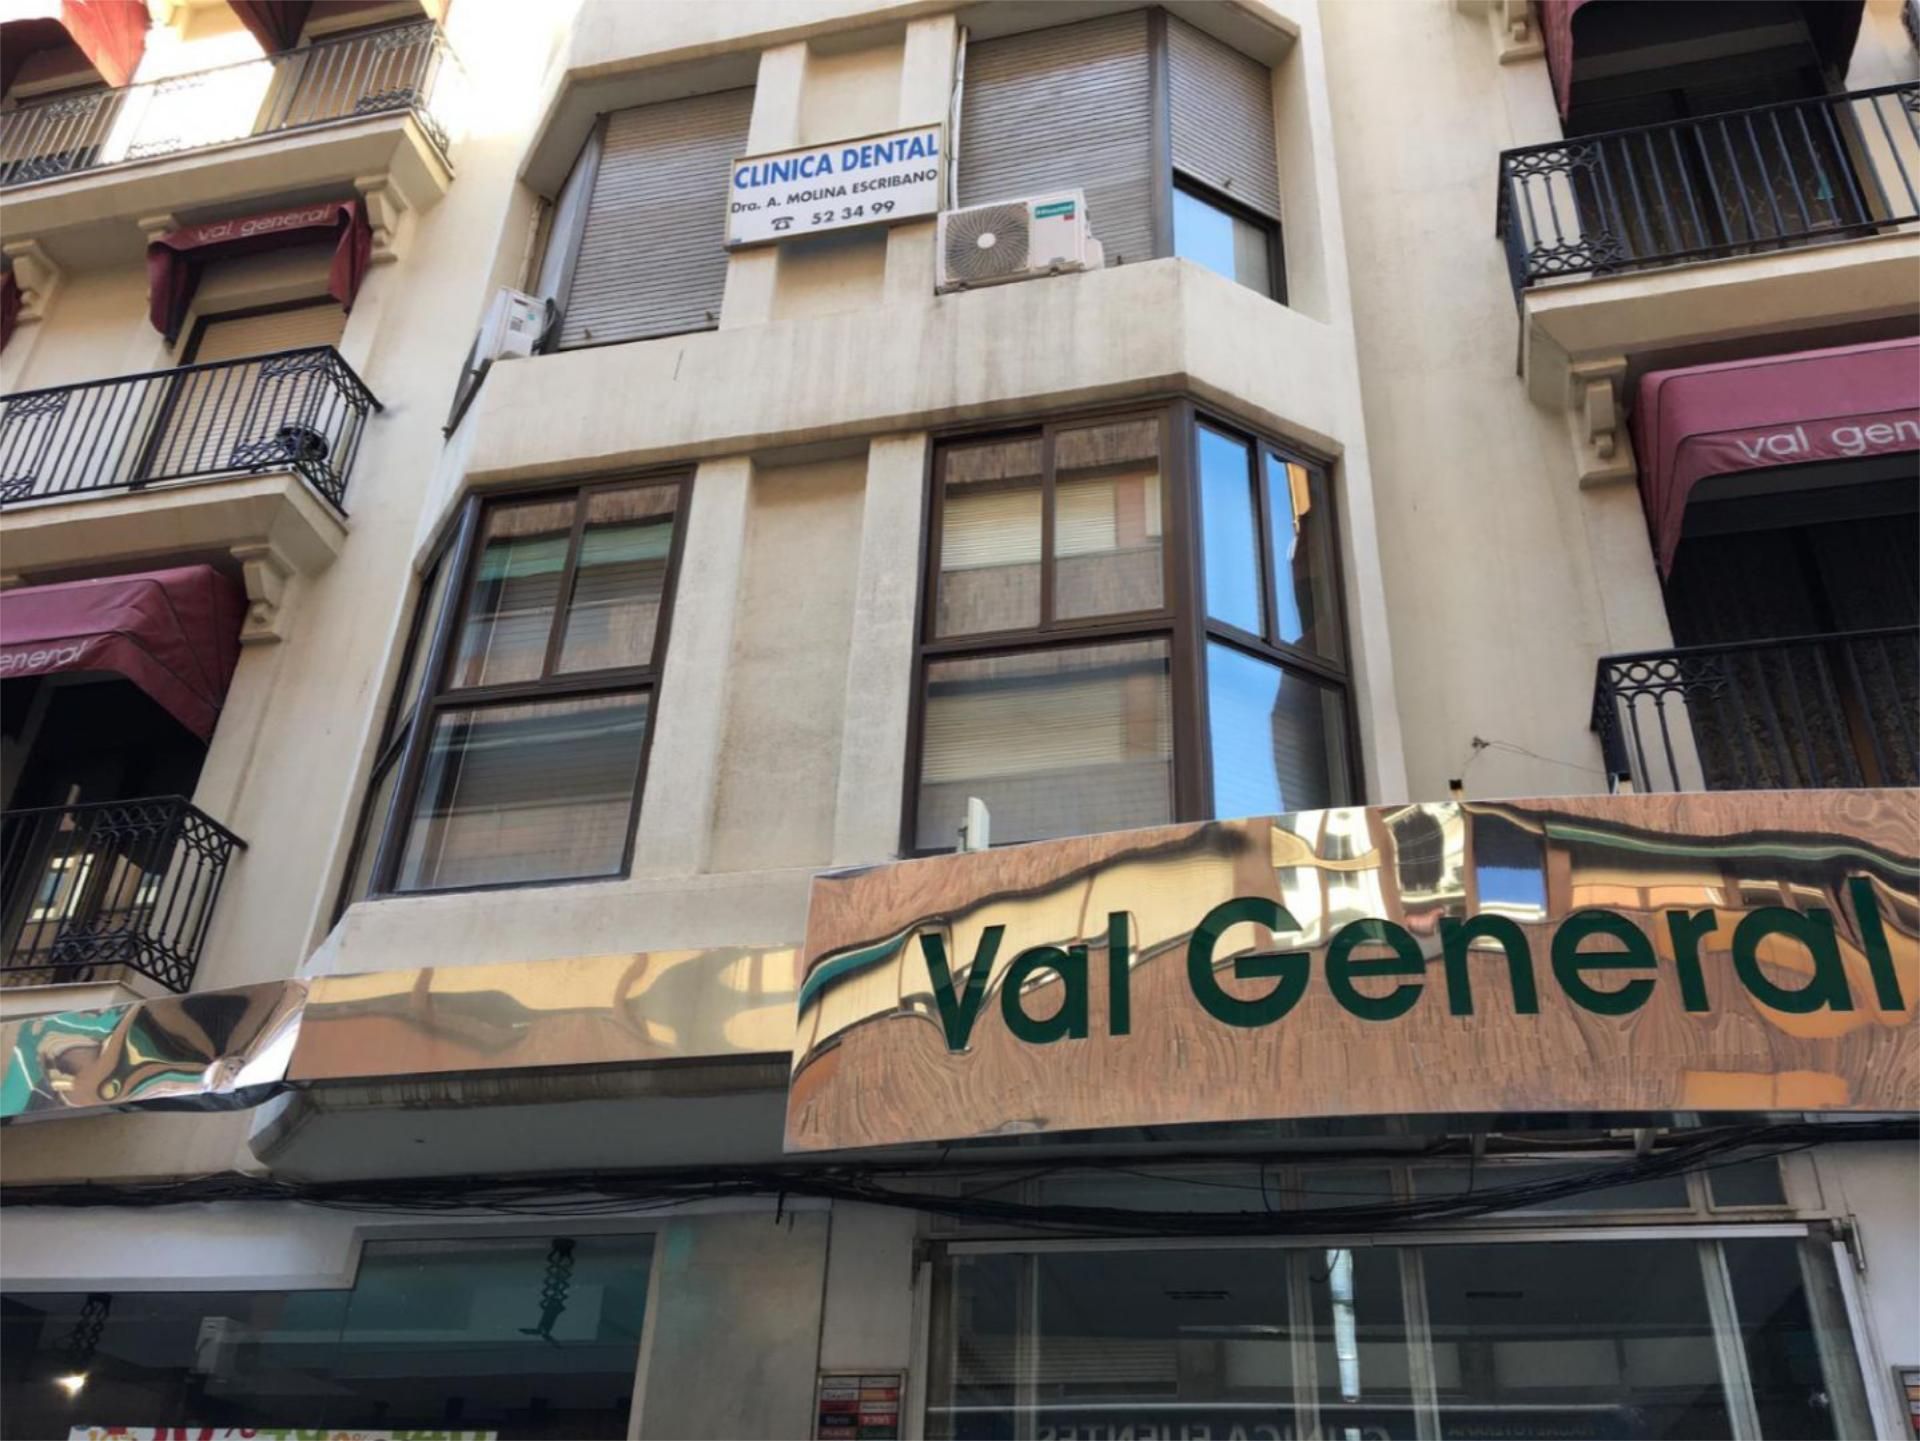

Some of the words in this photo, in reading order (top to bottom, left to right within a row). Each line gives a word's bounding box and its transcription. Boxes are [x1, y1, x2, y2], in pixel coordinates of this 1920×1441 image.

[734, 153, 833, 190] CLINICA
[841, 133, 939, 172] DENTAL
[731, 202, 761, 214] Dra.
[766, 197, 781, 209] A.
[786, 185, 847, 205] MOLINA
[851, 168, 938, 194] ESCRIBANO
[198, 221, 234, 241] val
[240, 204, 331, 237] general
[811, 210, 835, 225] 52
[840, 204, 864, 220] 34
[871, 200, 895, 215] 99
[1736, 425, 1810, 459] val
[919, 910, 1131, 1051] Val
[1187, 876, 1906, 1028] General
